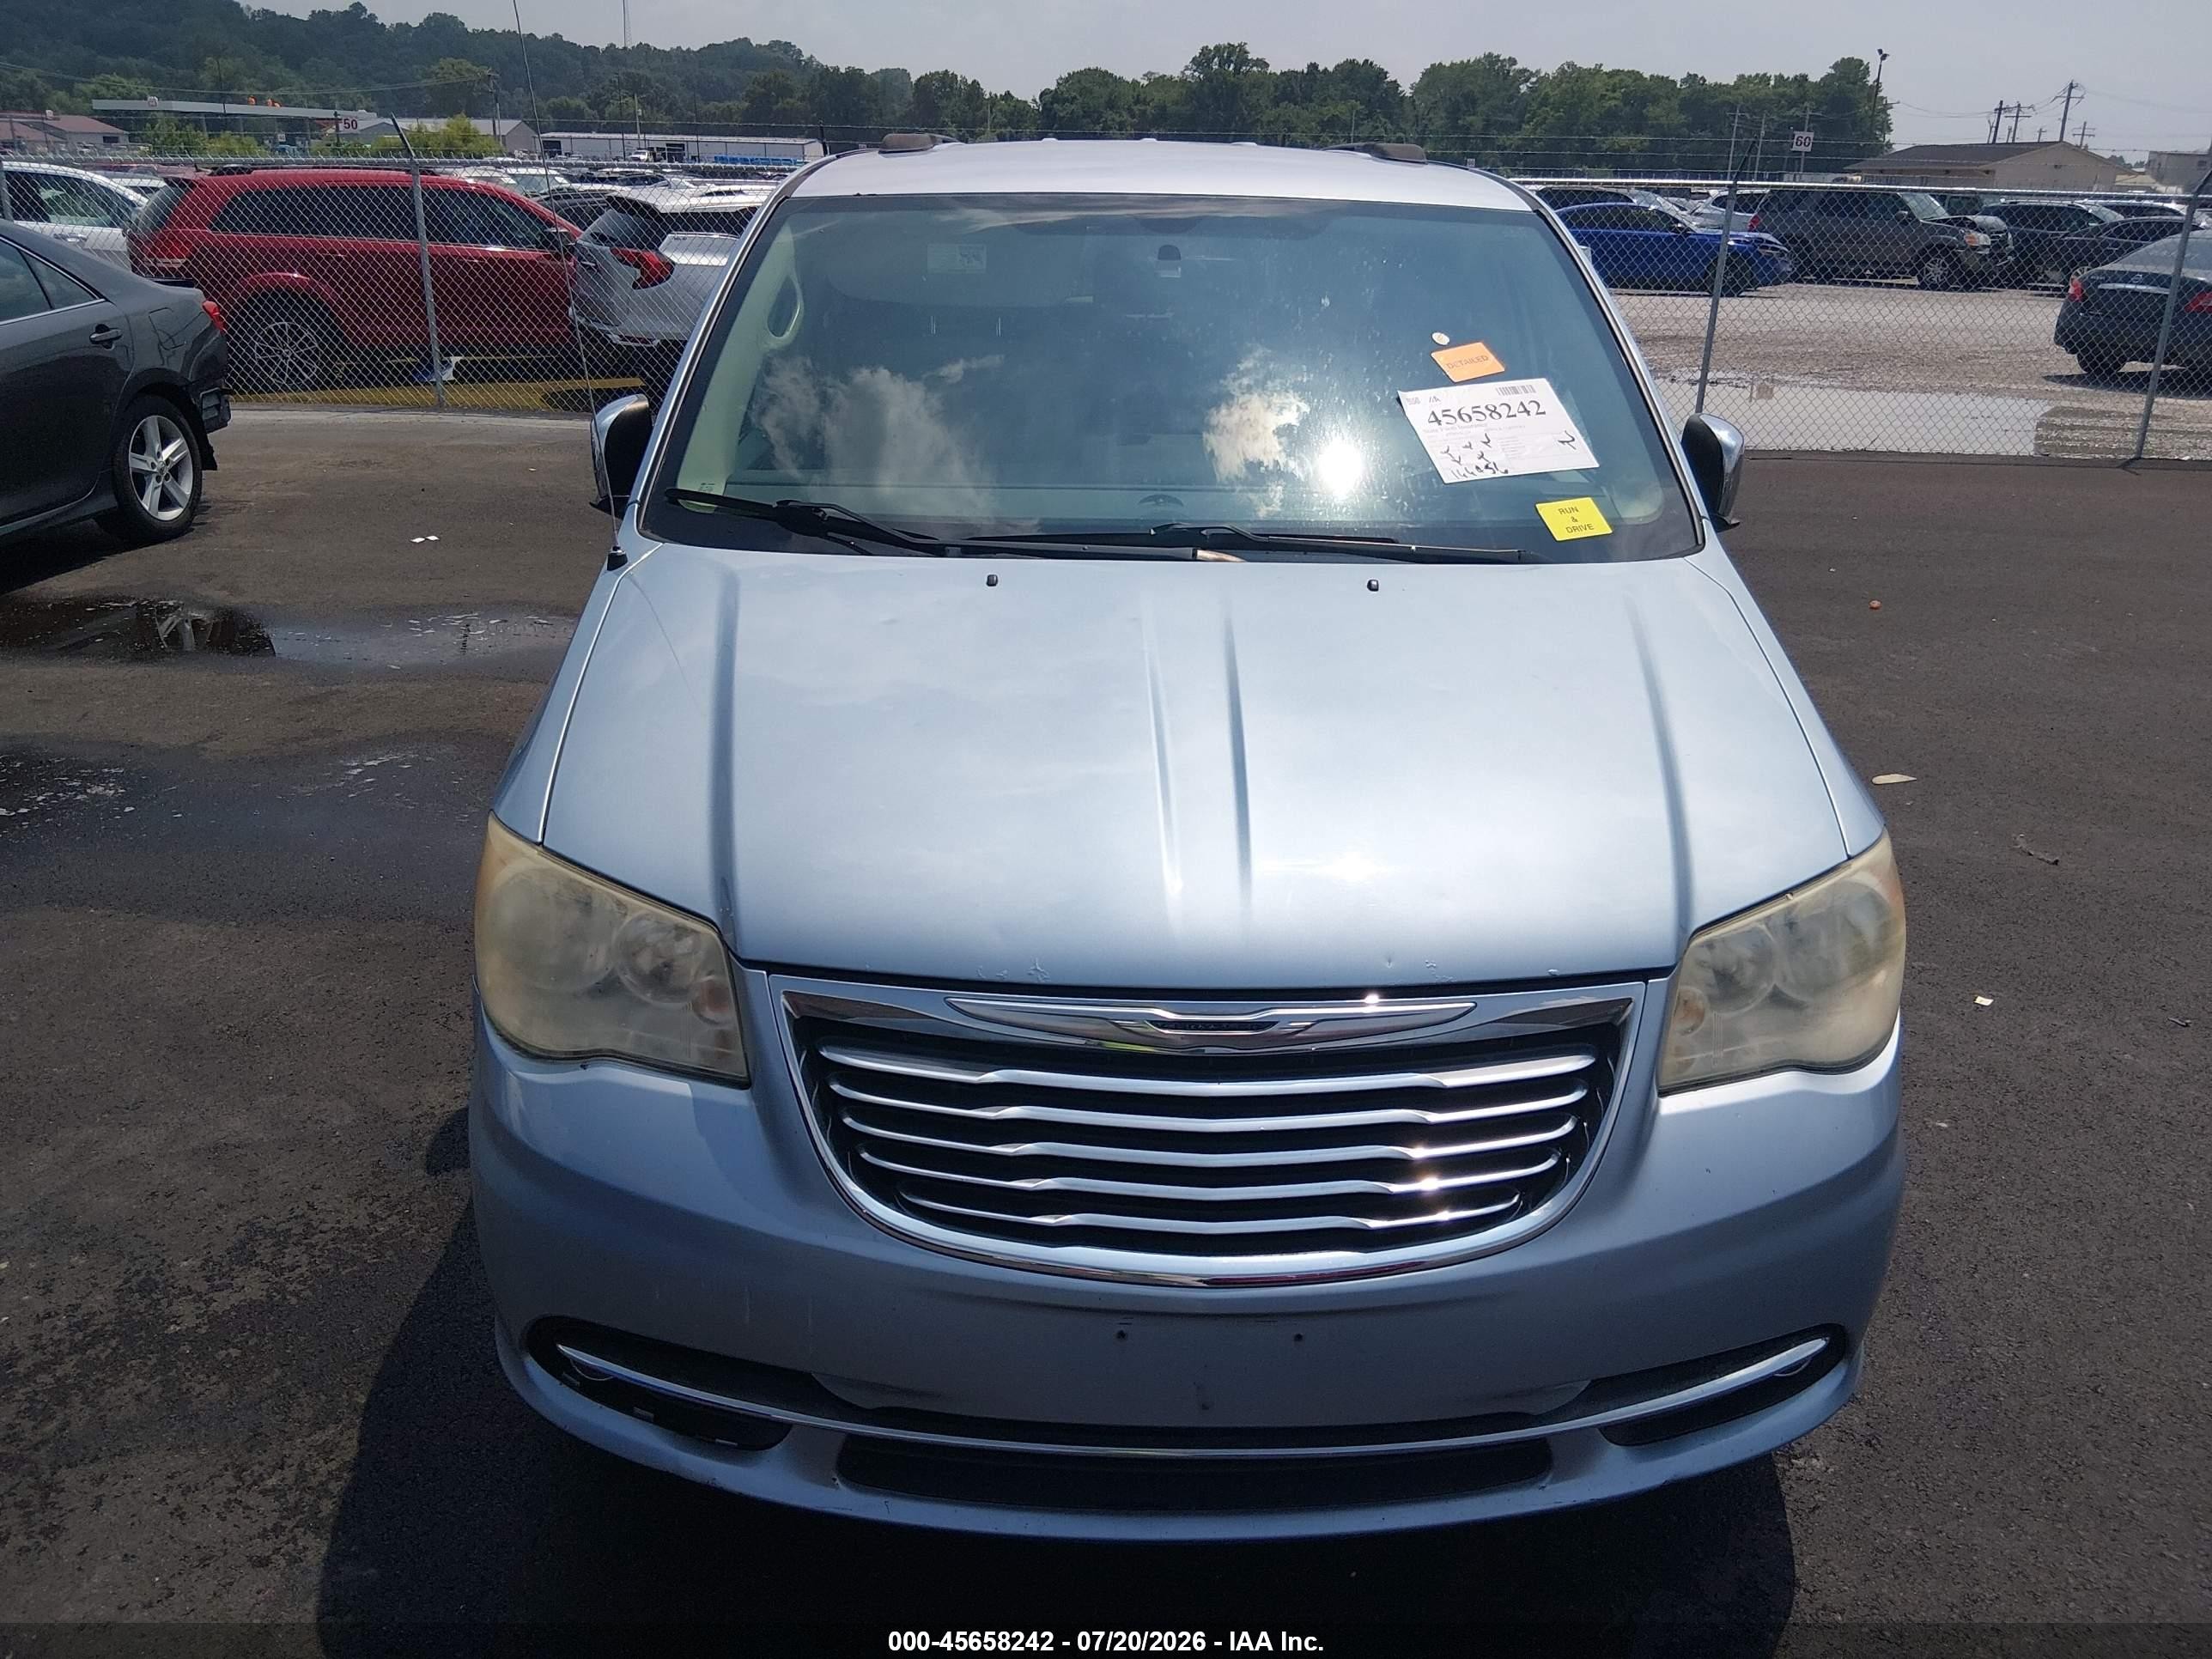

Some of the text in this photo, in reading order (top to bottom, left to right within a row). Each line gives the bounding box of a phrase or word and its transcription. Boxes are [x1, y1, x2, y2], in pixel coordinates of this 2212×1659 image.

[343, 118, 358, 130] 50
[1796, 136, 1811, 147] 60
[1446, 355, 1489, 369] DETAILED
[1427, 399, 1547, 426] 45658242
[1558, 506, 1580, 515] RUN
[1565, 523, 1595, 533] DRIVE
